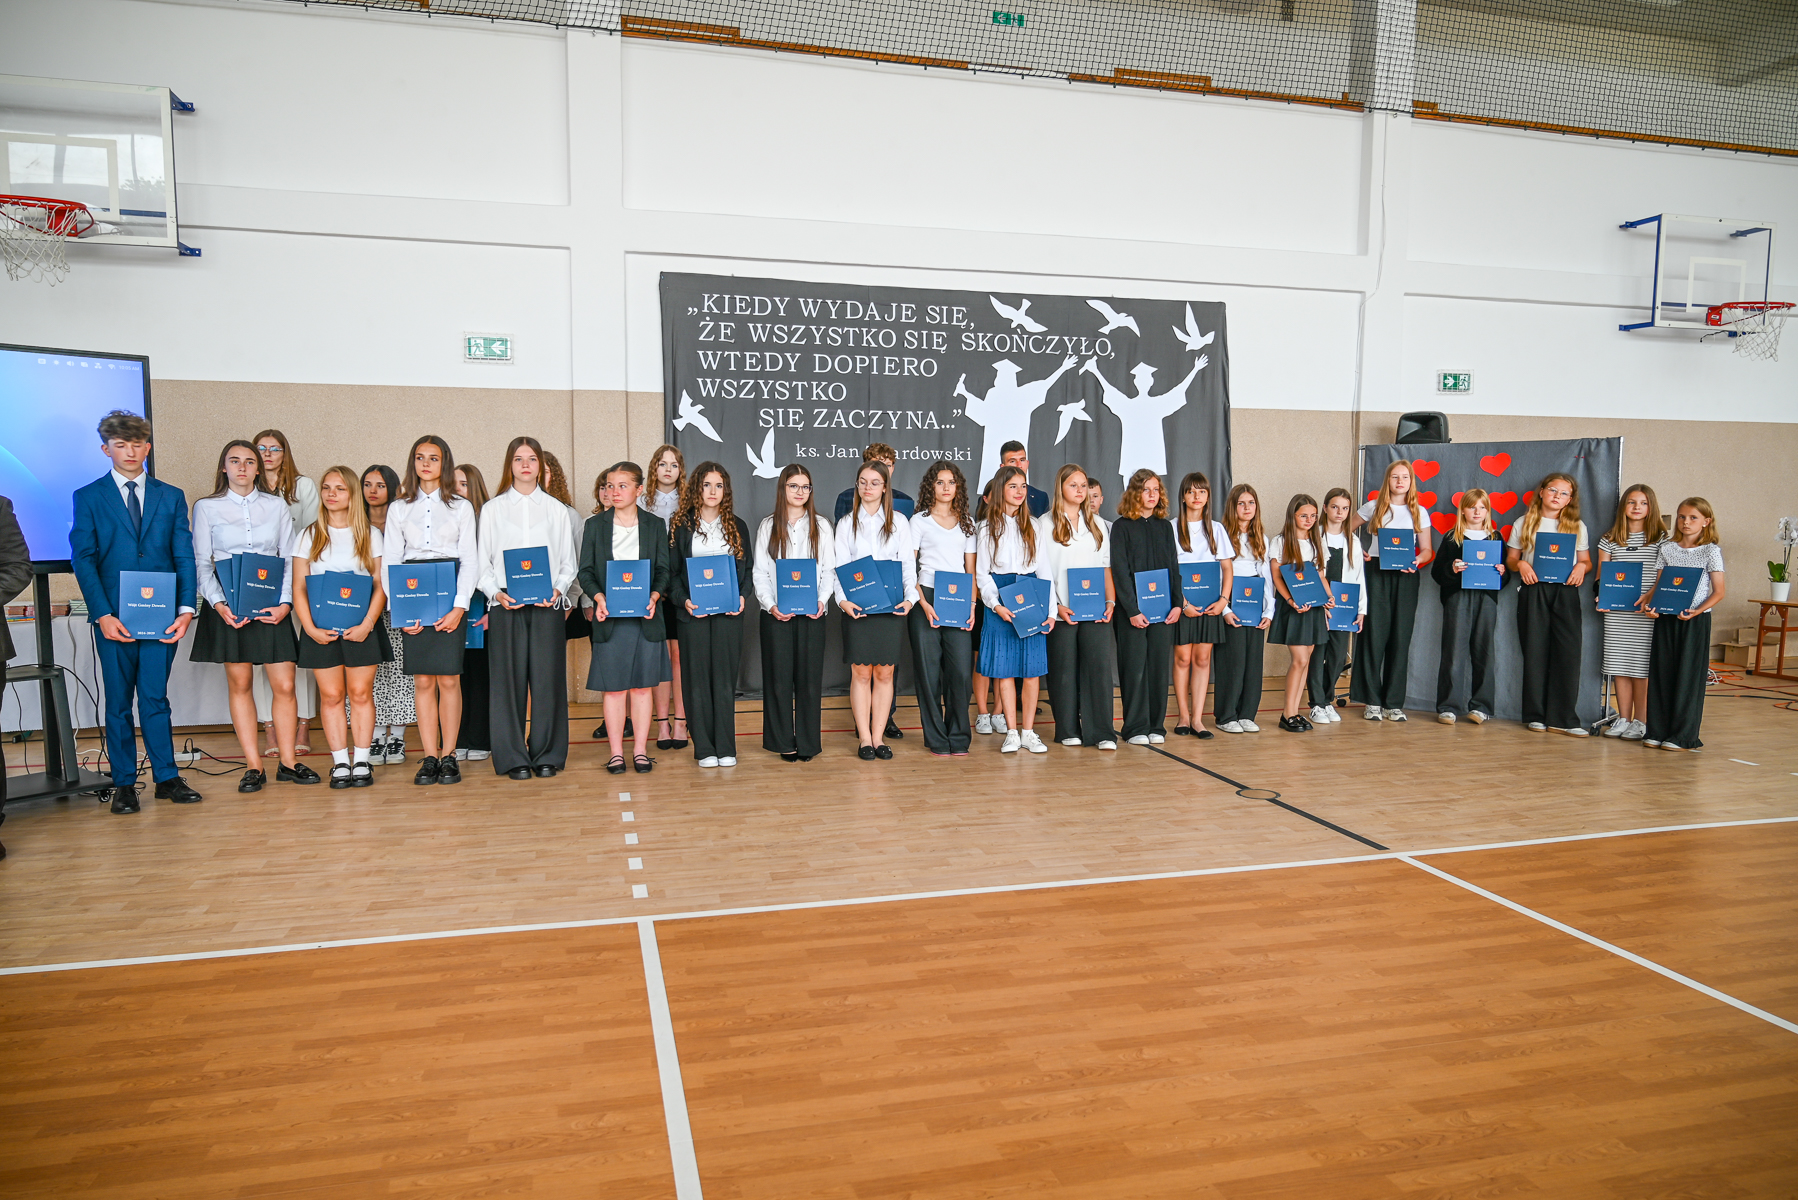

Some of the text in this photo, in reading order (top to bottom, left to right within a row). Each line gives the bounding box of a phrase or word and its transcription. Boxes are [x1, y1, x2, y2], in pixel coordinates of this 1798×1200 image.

[687, 293, 975, 329] „KIEDY WYDAJE SIĘ,
[698, 316, 1116, 359] ŻE WSZYSTKO SIĘ SKOŃCZYŁO,
[697, 350, 938, 378] WTEDY DOPIERO
[696, 378, 847, 401] WSZYSTKO
[759, 408, 805, 431] SIĘ
[796, 443, 972, 461] ks. Jan ardowski
